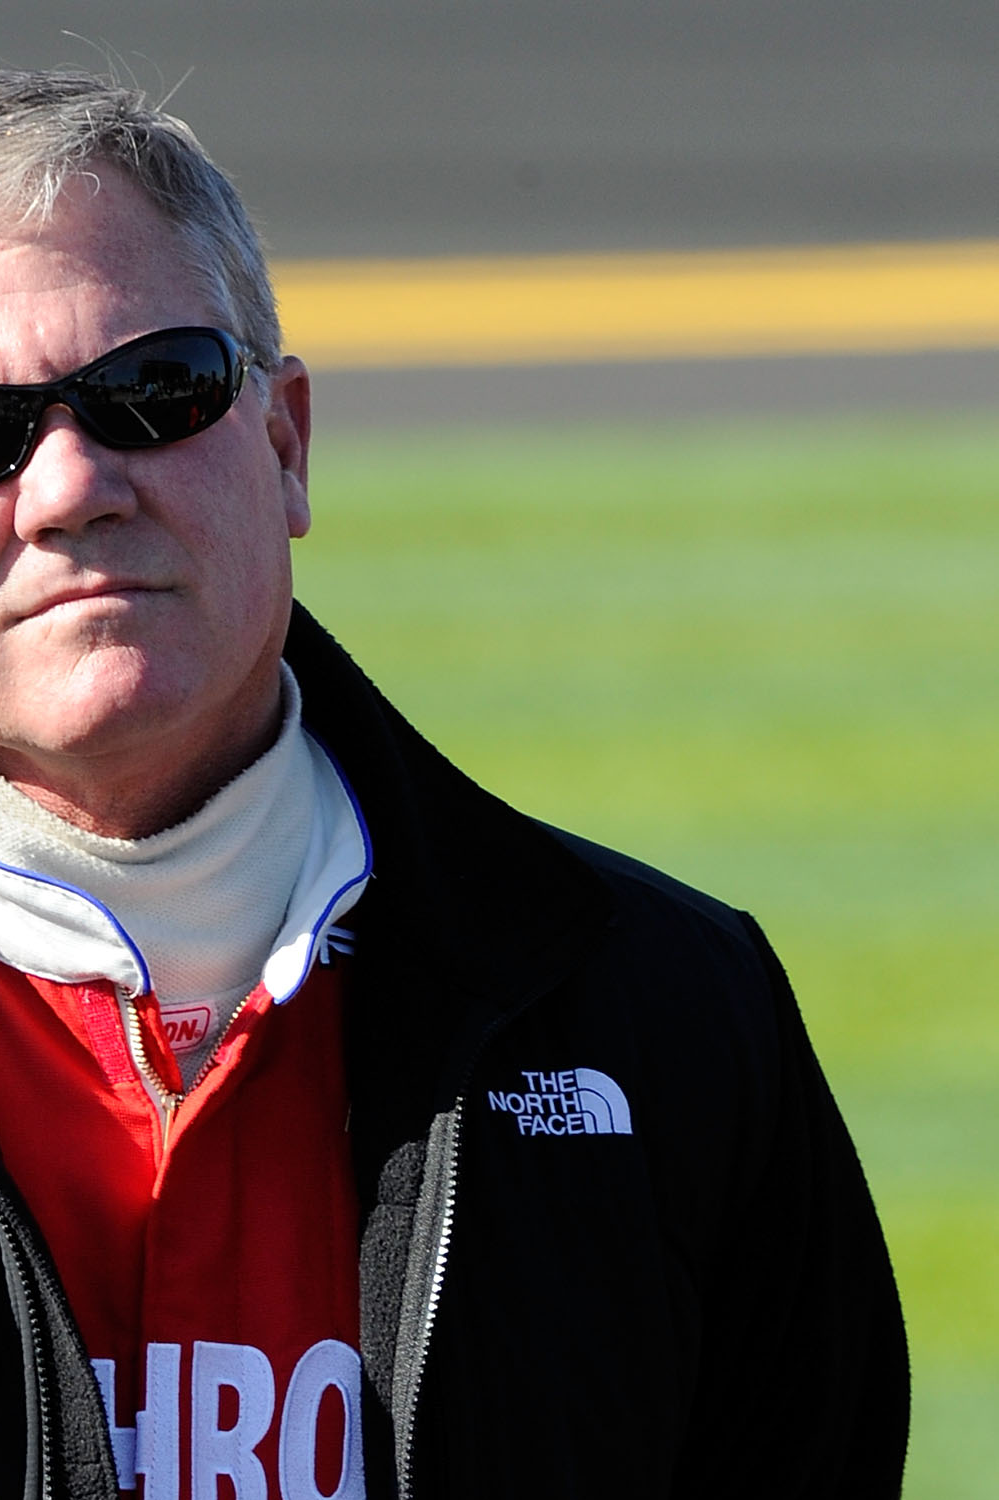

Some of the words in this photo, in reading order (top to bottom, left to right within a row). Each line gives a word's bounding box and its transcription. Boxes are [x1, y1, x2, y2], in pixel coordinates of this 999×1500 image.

[521, 1071, 577, 1093] THE
[488, 1090, 581, 1114] NORTH
[517, 1113, 585, 1136] FACE
